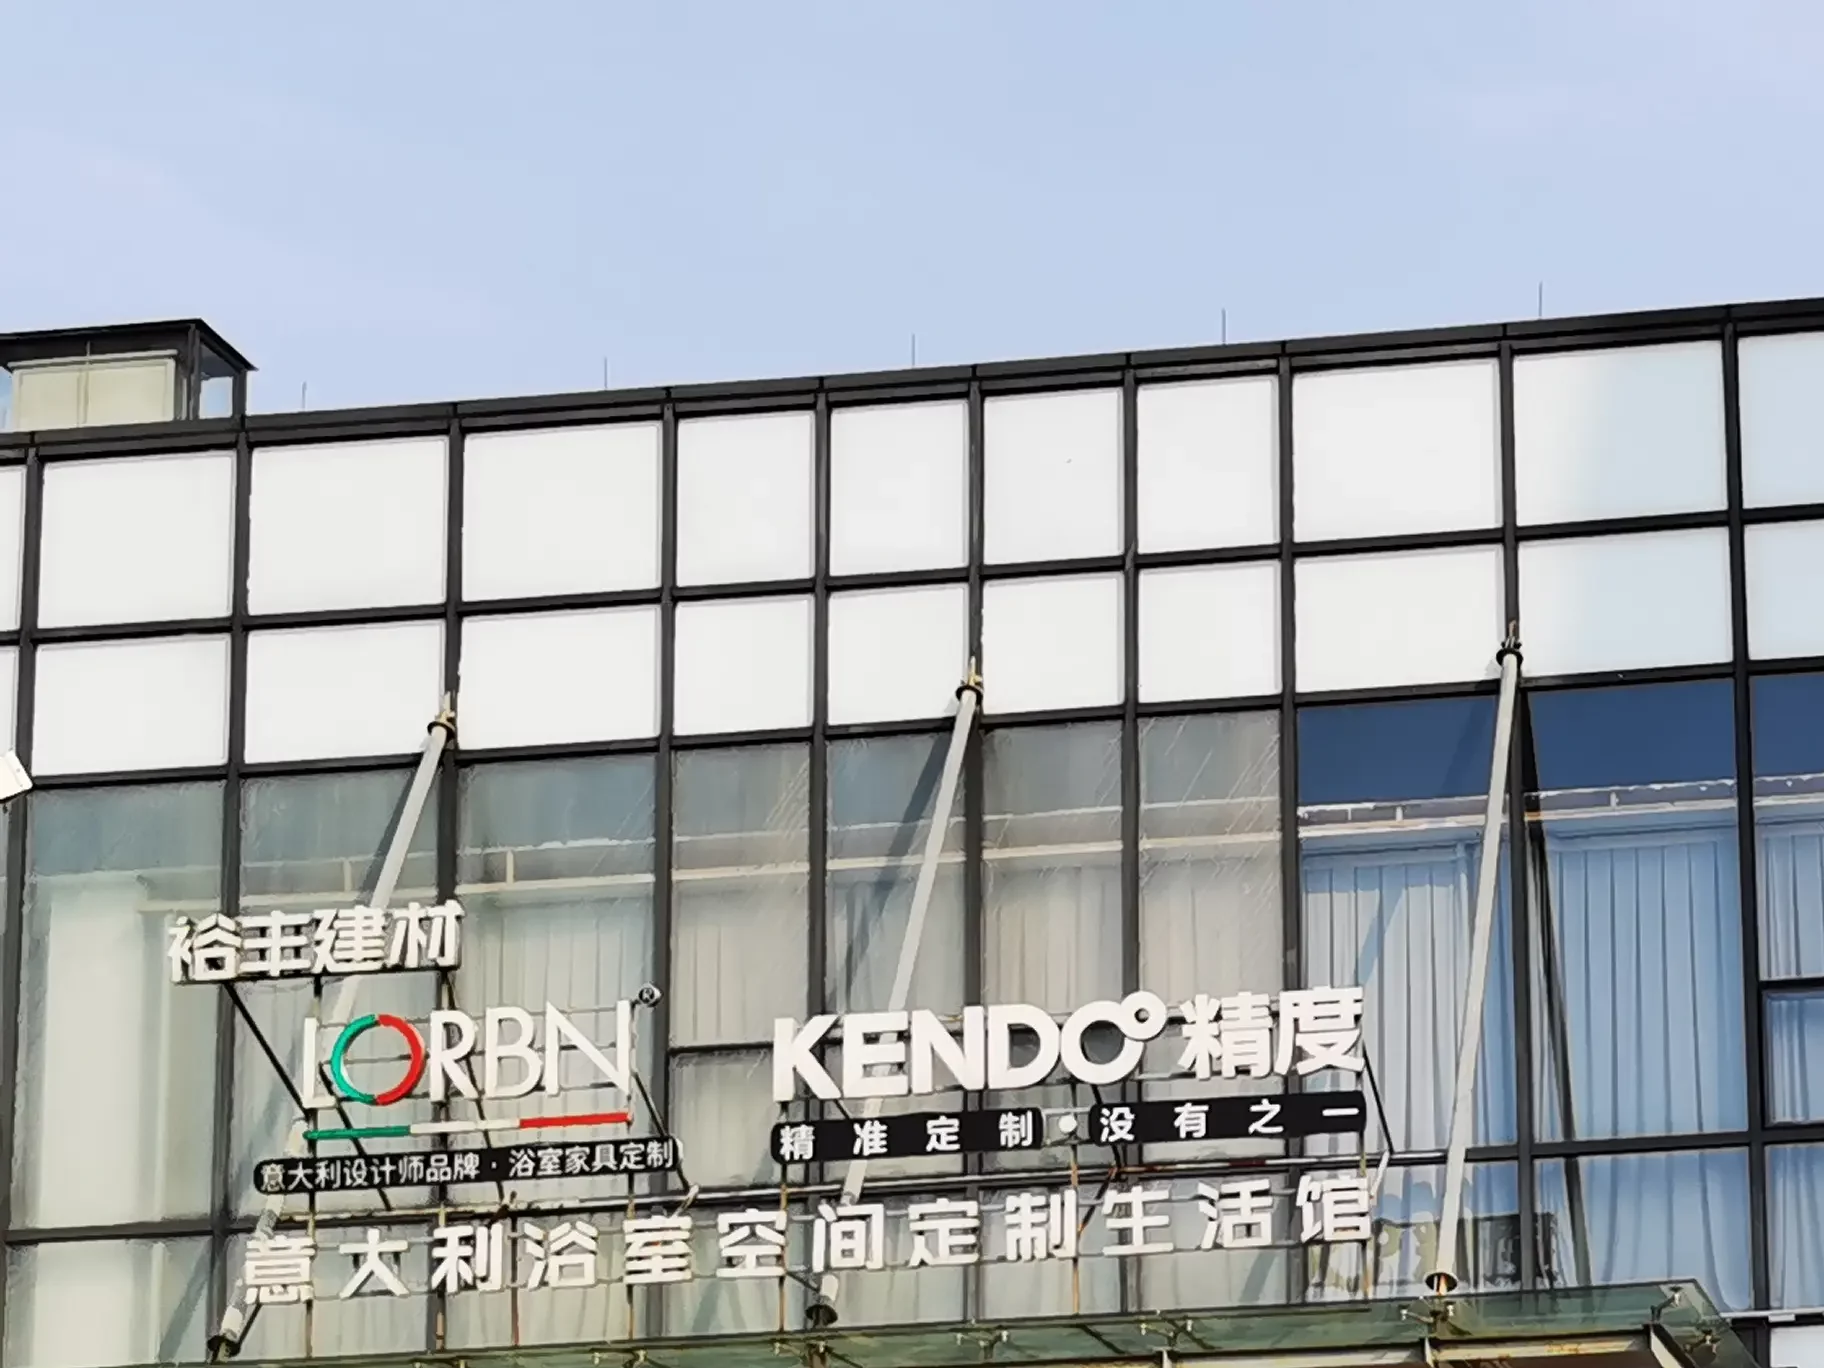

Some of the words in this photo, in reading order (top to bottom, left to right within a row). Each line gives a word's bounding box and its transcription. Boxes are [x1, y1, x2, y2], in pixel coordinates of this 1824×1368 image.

[167, 899, 465, 983] 裕丰建材
[1177, 985, 1365, 1081] 精度
[243, 1175, 1374, 1304] 意大利浴室空间定制生活馆
